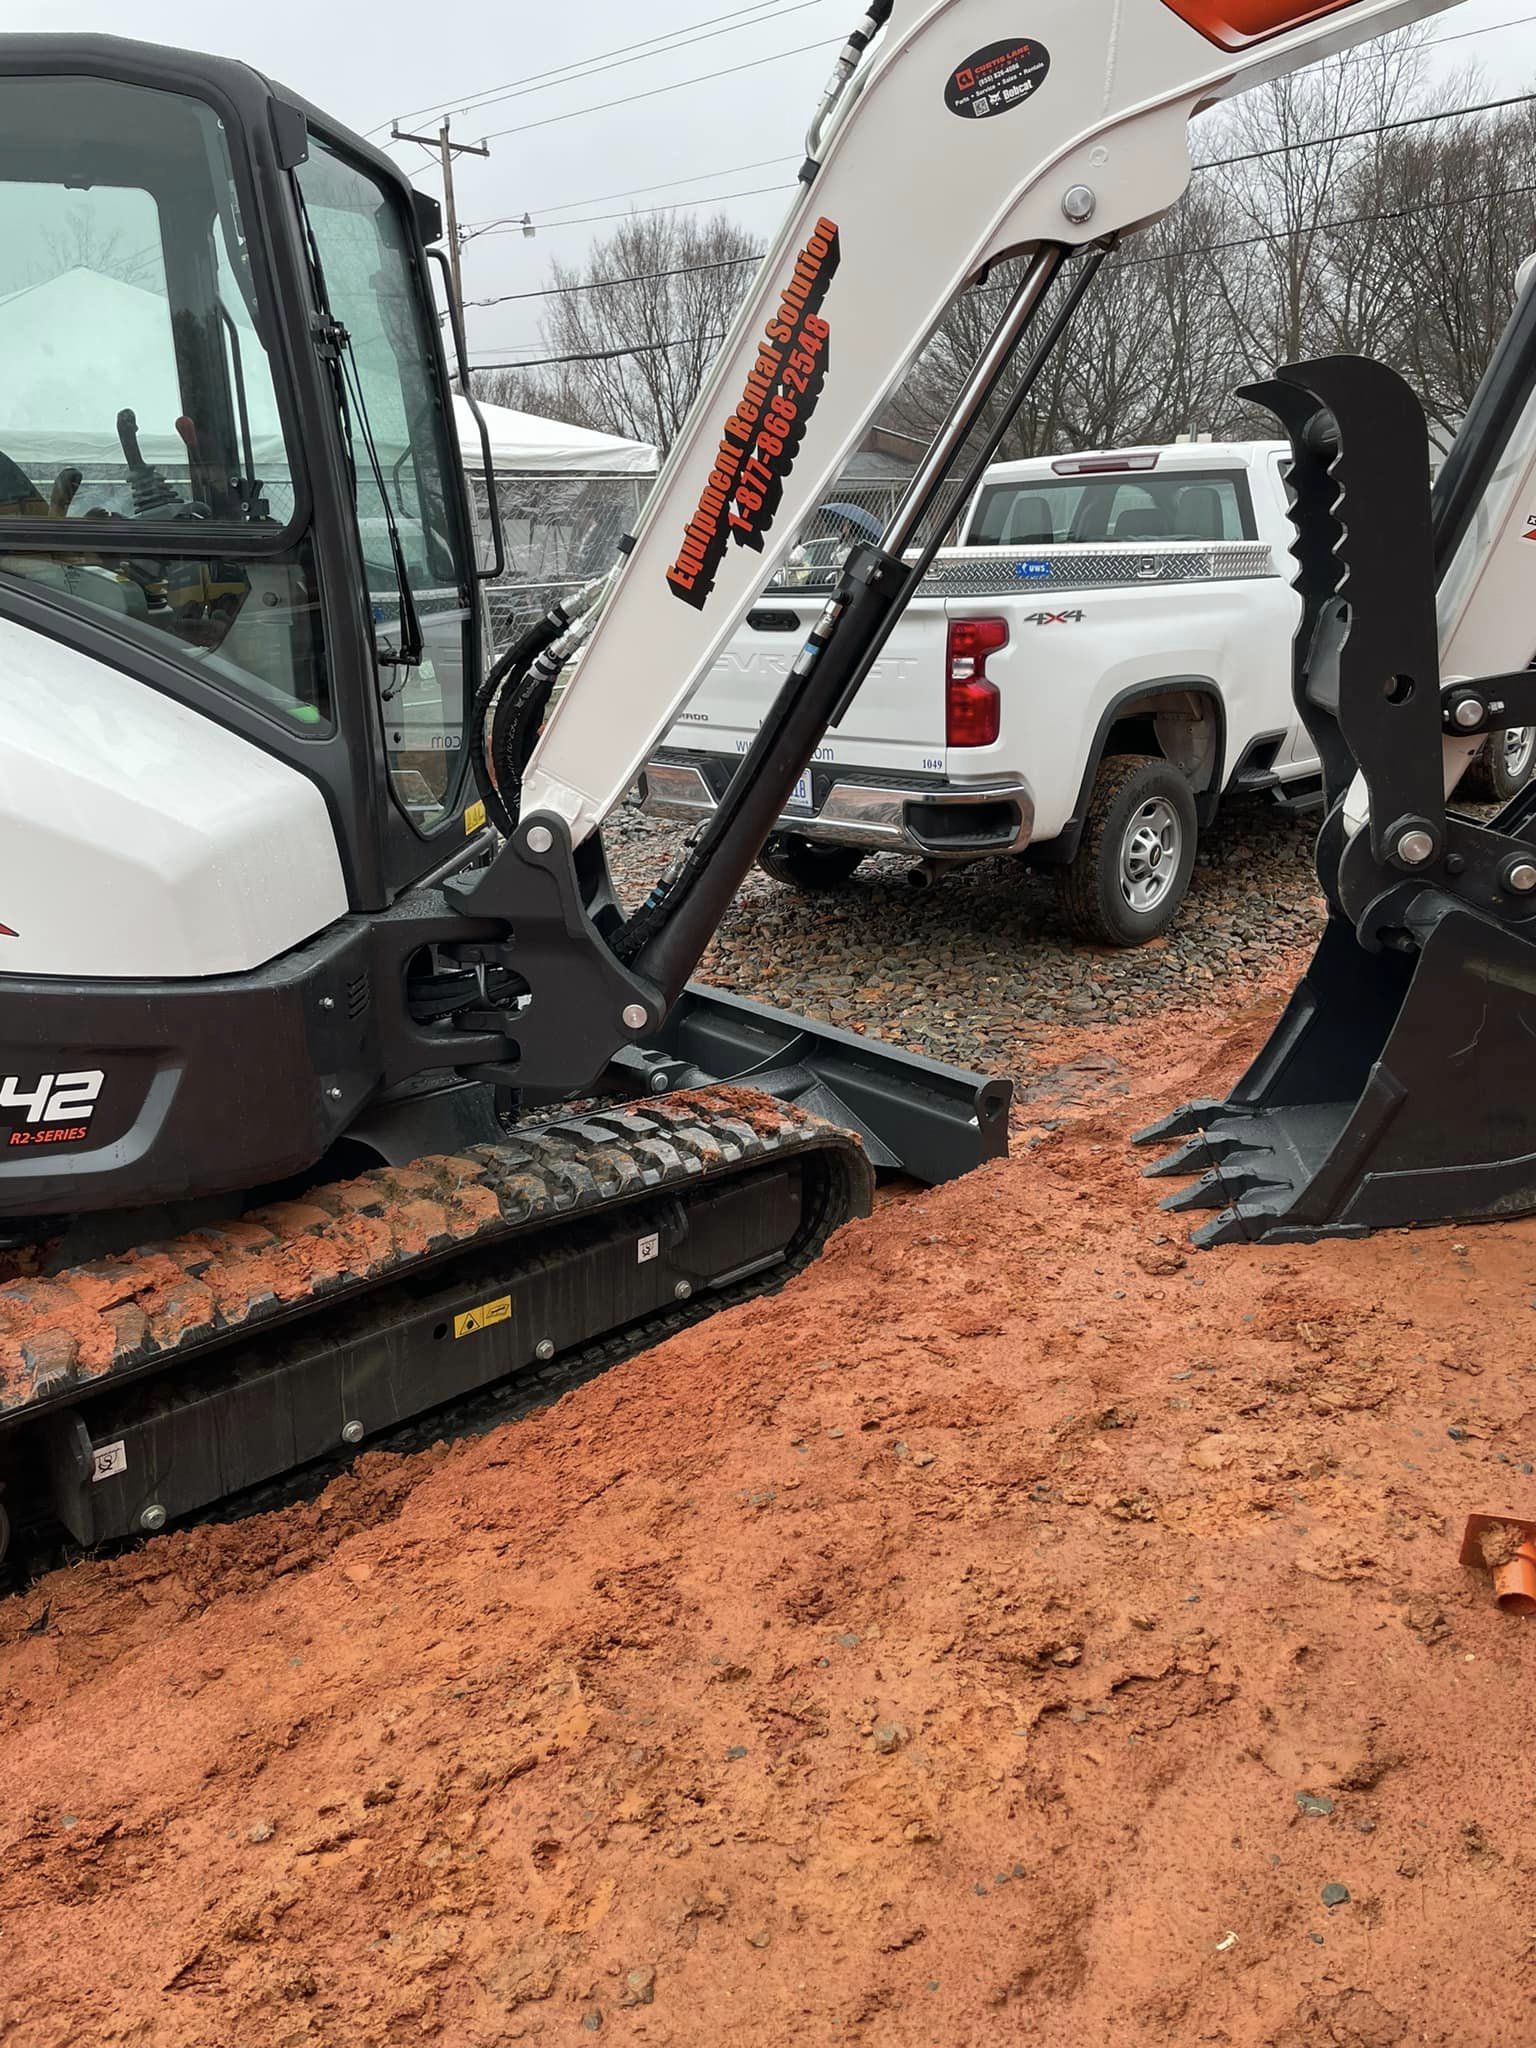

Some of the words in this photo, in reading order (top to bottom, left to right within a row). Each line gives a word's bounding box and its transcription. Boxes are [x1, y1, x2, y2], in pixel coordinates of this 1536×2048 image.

[974, 55, 1006, 74] CURTIS
[1006, 44, 1031, 59] LANE
[955, 96, 970, 107] Parts
[975, 84, 996, 97] Service
[1002, 75, 1018, 85] Sales
[1023, 62, 1044, 75] Rentals
[1002, 79, 1033, 100] Bobcat
[666, 436, 744, 590] Equipment
[724, 341, 783, 442] Rental
[766, 215, 839, 345] Solution
[727, 313, 830, 533] 1-877-868-2548
[922, 759, 943, 769] 1049
[10, 1126, 87, 1145] R2-SERIES
